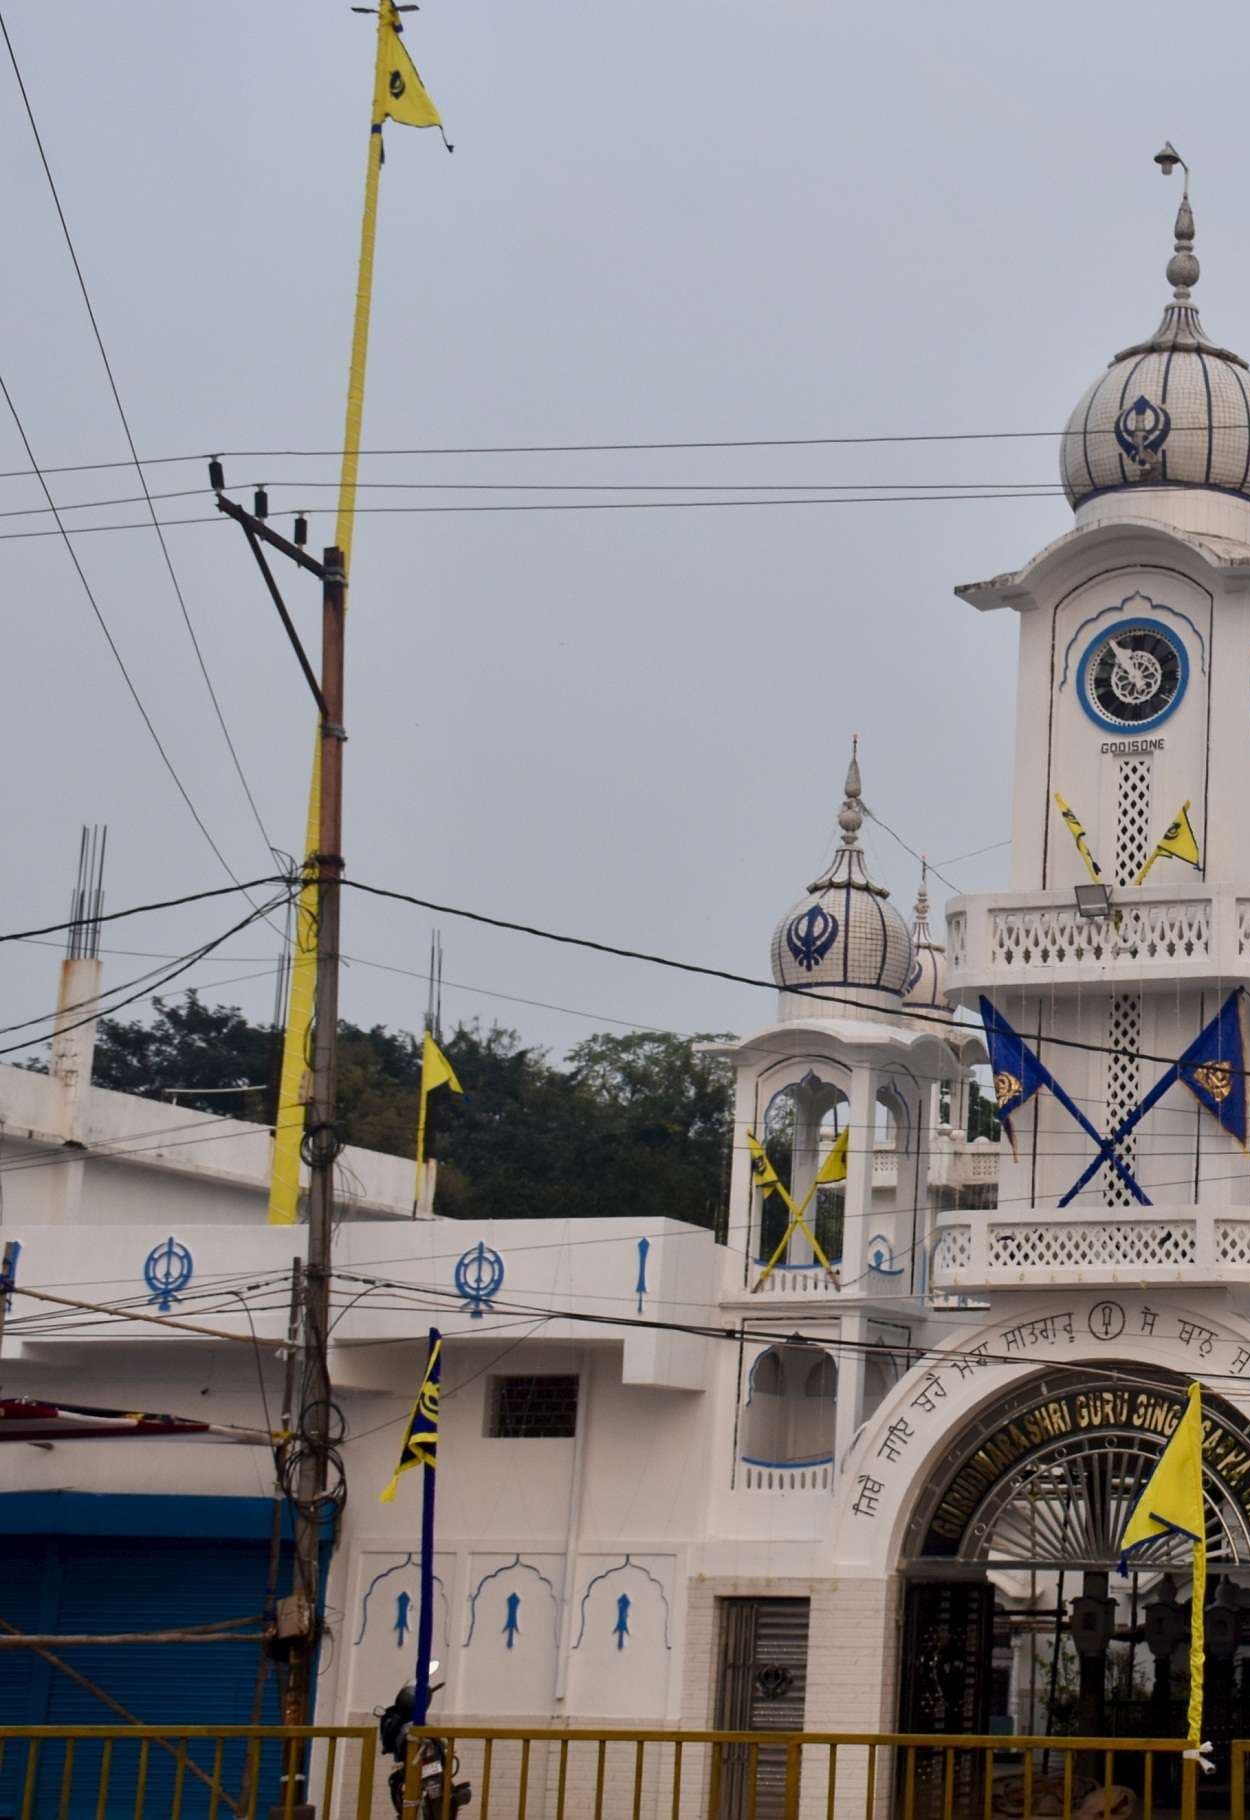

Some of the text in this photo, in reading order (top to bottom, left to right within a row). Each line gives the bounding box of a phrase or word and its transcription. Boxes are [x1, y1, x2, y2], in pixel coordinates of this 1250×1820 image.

[1024, 1400, 1072, 1444] SHRI
[1076, 1392, 1129, 1428] GURU
[1132, 1393, 1184, 1437] SING
